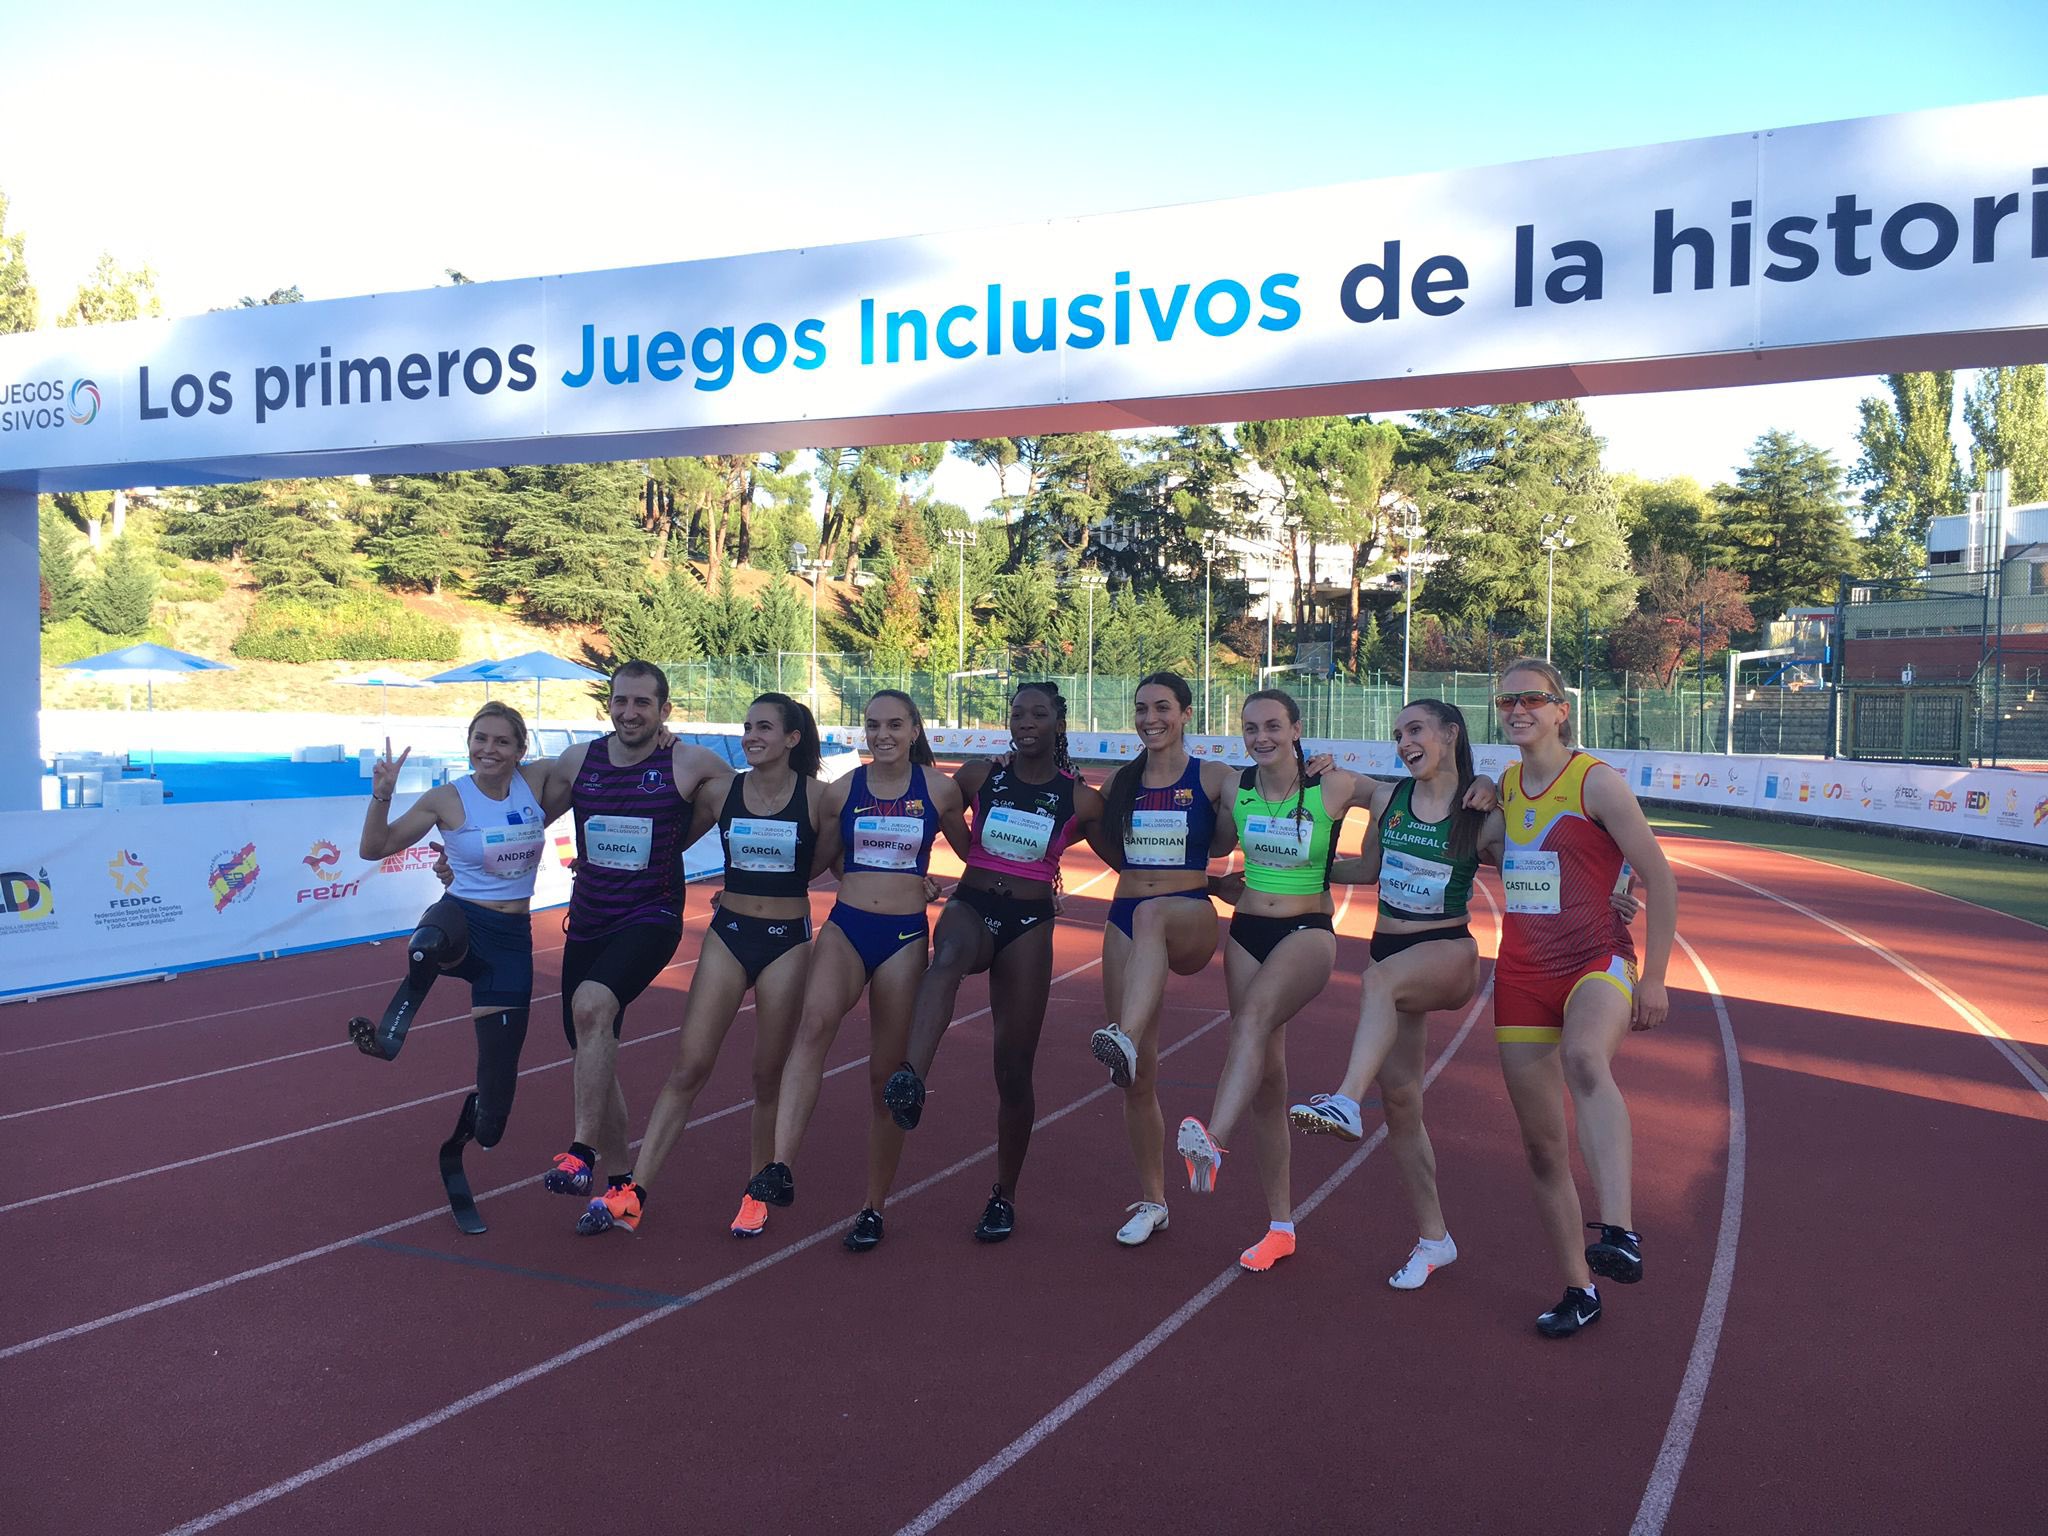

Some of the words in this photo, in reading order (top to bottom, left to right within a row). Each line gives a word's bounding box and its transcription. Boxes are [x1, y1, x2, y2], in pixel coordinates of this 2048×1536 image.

[140, 366, 232, 421] Los
[255, 343, 537, 424] primeros
[561, 317, 827, 392] Juegos
[861, 270, 1301, 365] Inclusivos
[1340, 240, 1469, 324] de
[1514, 224, 1604, 308] la
[1653, 167, 2048, 294] histori
[990, 830, 1038, 848] SANTANA
[1125, 837, 1184, 846] SANTIDRIAN
[1384, 829, 1440, 848] VILLARREAL
[597, 843, 637, 853] GARCÍA
[741, 846, 782, 855] GARCÍA
[863, 839, 912, 851] BORRERO
[1255, 844, 1298, 856] AGUILAR
[1389, 878, 1430, 896] SEVILLA
[1505, 881, 1550, 891] CASTILLO
[110, 895, 162, 909] FEDPC
[768, 926, 784, 935] GO
